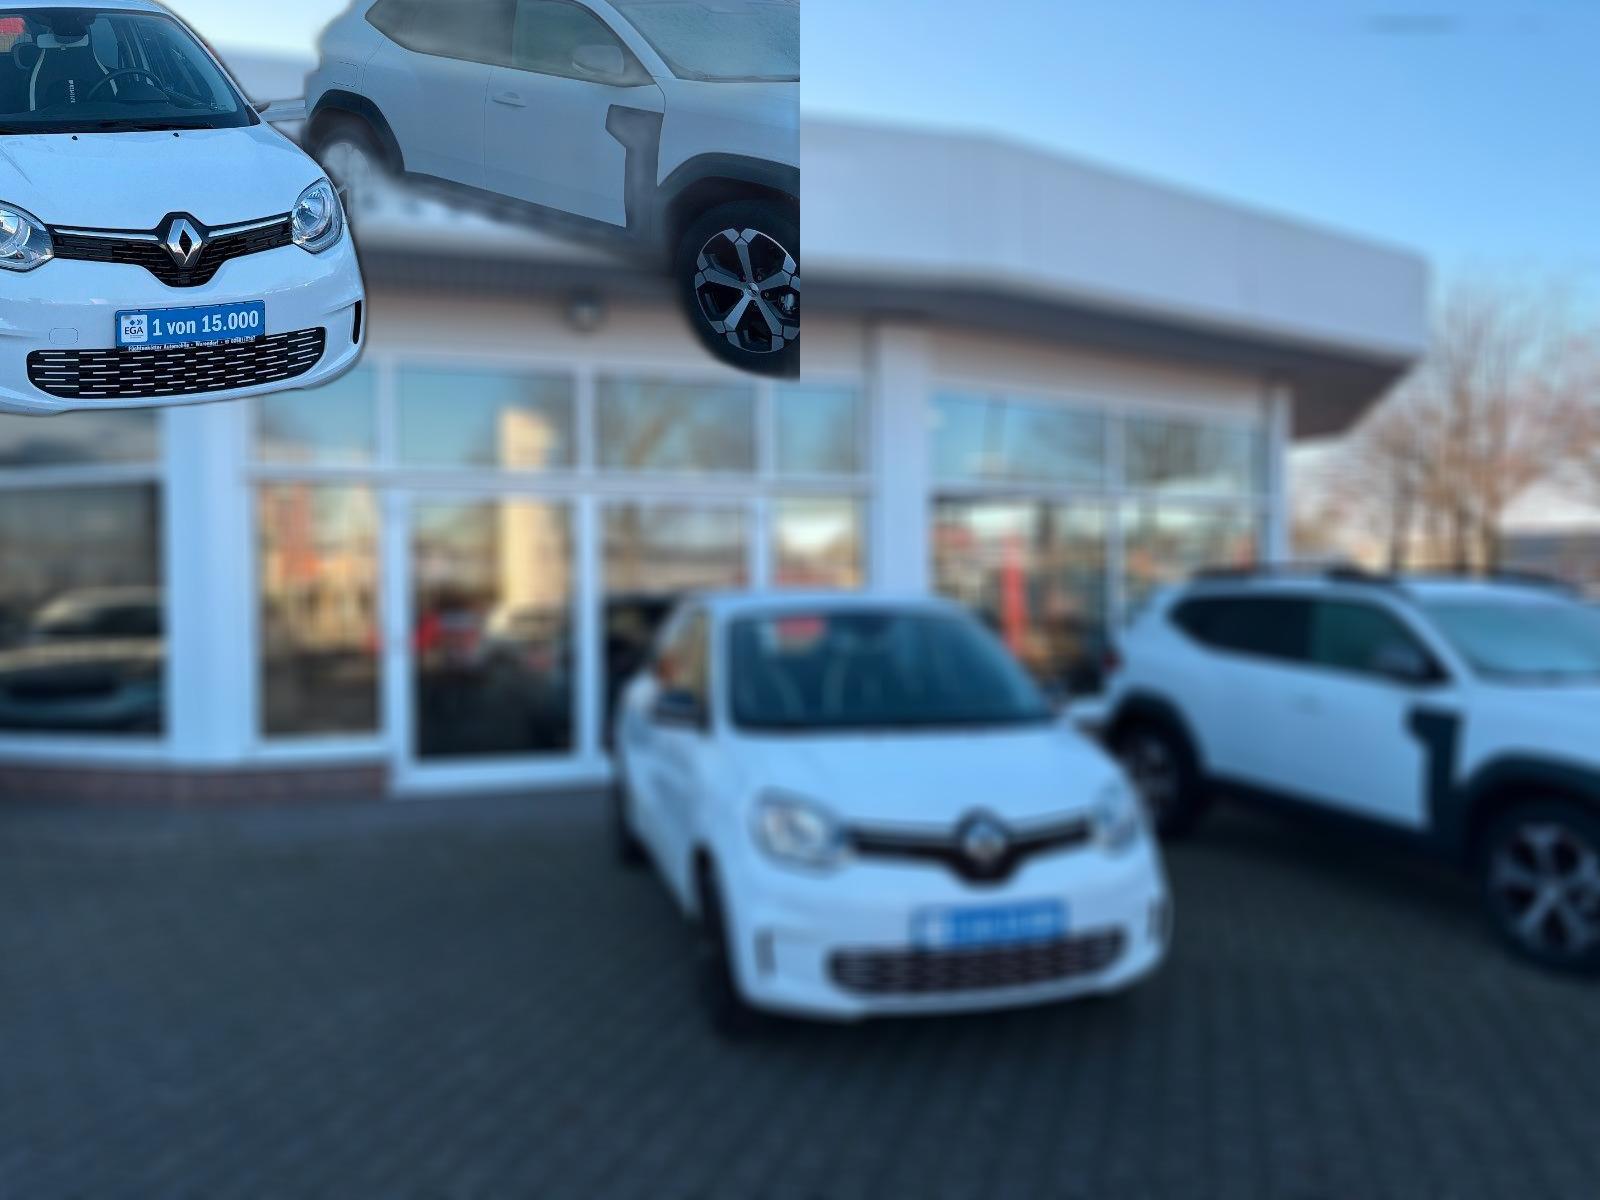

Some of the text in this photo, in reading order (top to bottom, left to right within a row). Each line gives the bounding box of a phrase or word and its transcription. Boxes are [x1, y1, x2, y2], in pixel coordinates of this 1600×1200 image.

[124, 327, 144, 335] EGA
[153, 310, 259, 336] 1 von 15.000
